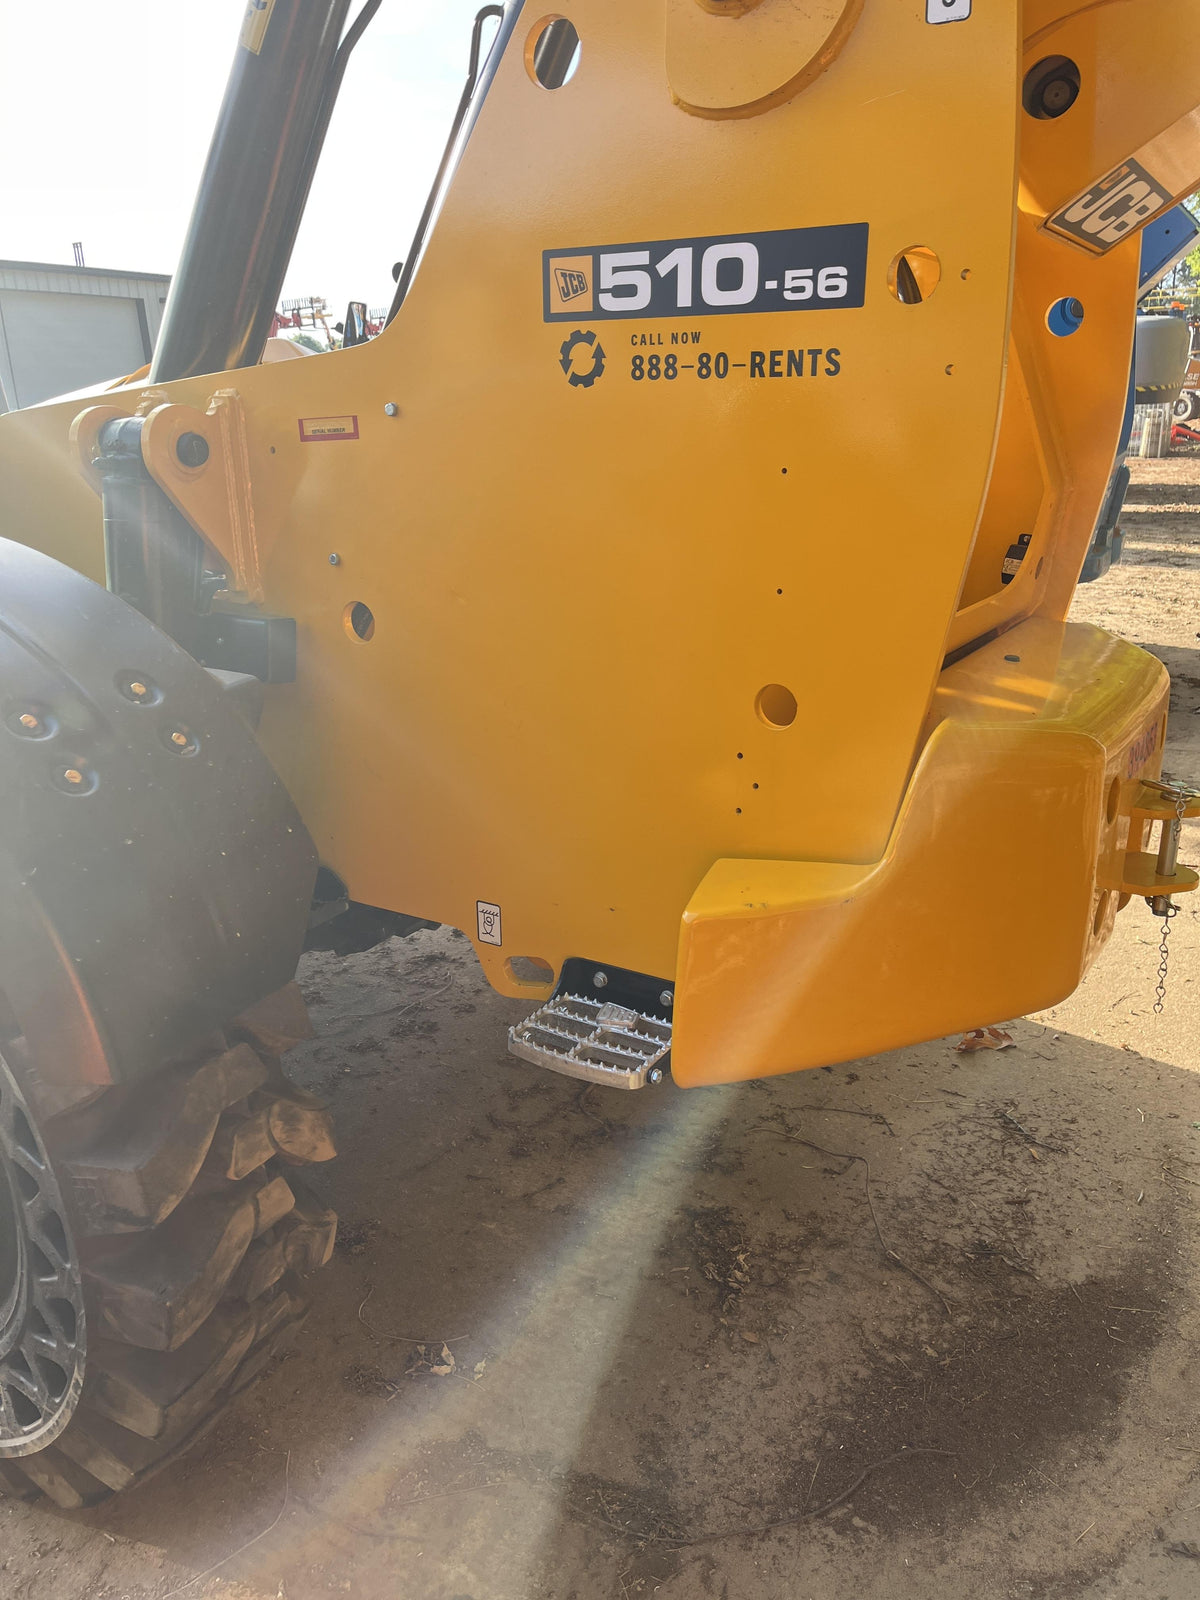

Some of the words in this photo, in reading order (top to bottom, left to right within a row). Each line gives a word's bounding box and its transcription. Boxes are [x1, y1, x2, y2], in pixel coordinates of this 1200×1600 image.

[1064, 173, 1164, 243] JCB
[559, 271, 587, 296] JCB
[598, 242, 848, 312] 510-56
[631, 333, 664, 346] CALL
[671, 331, 702, 345] NOW
